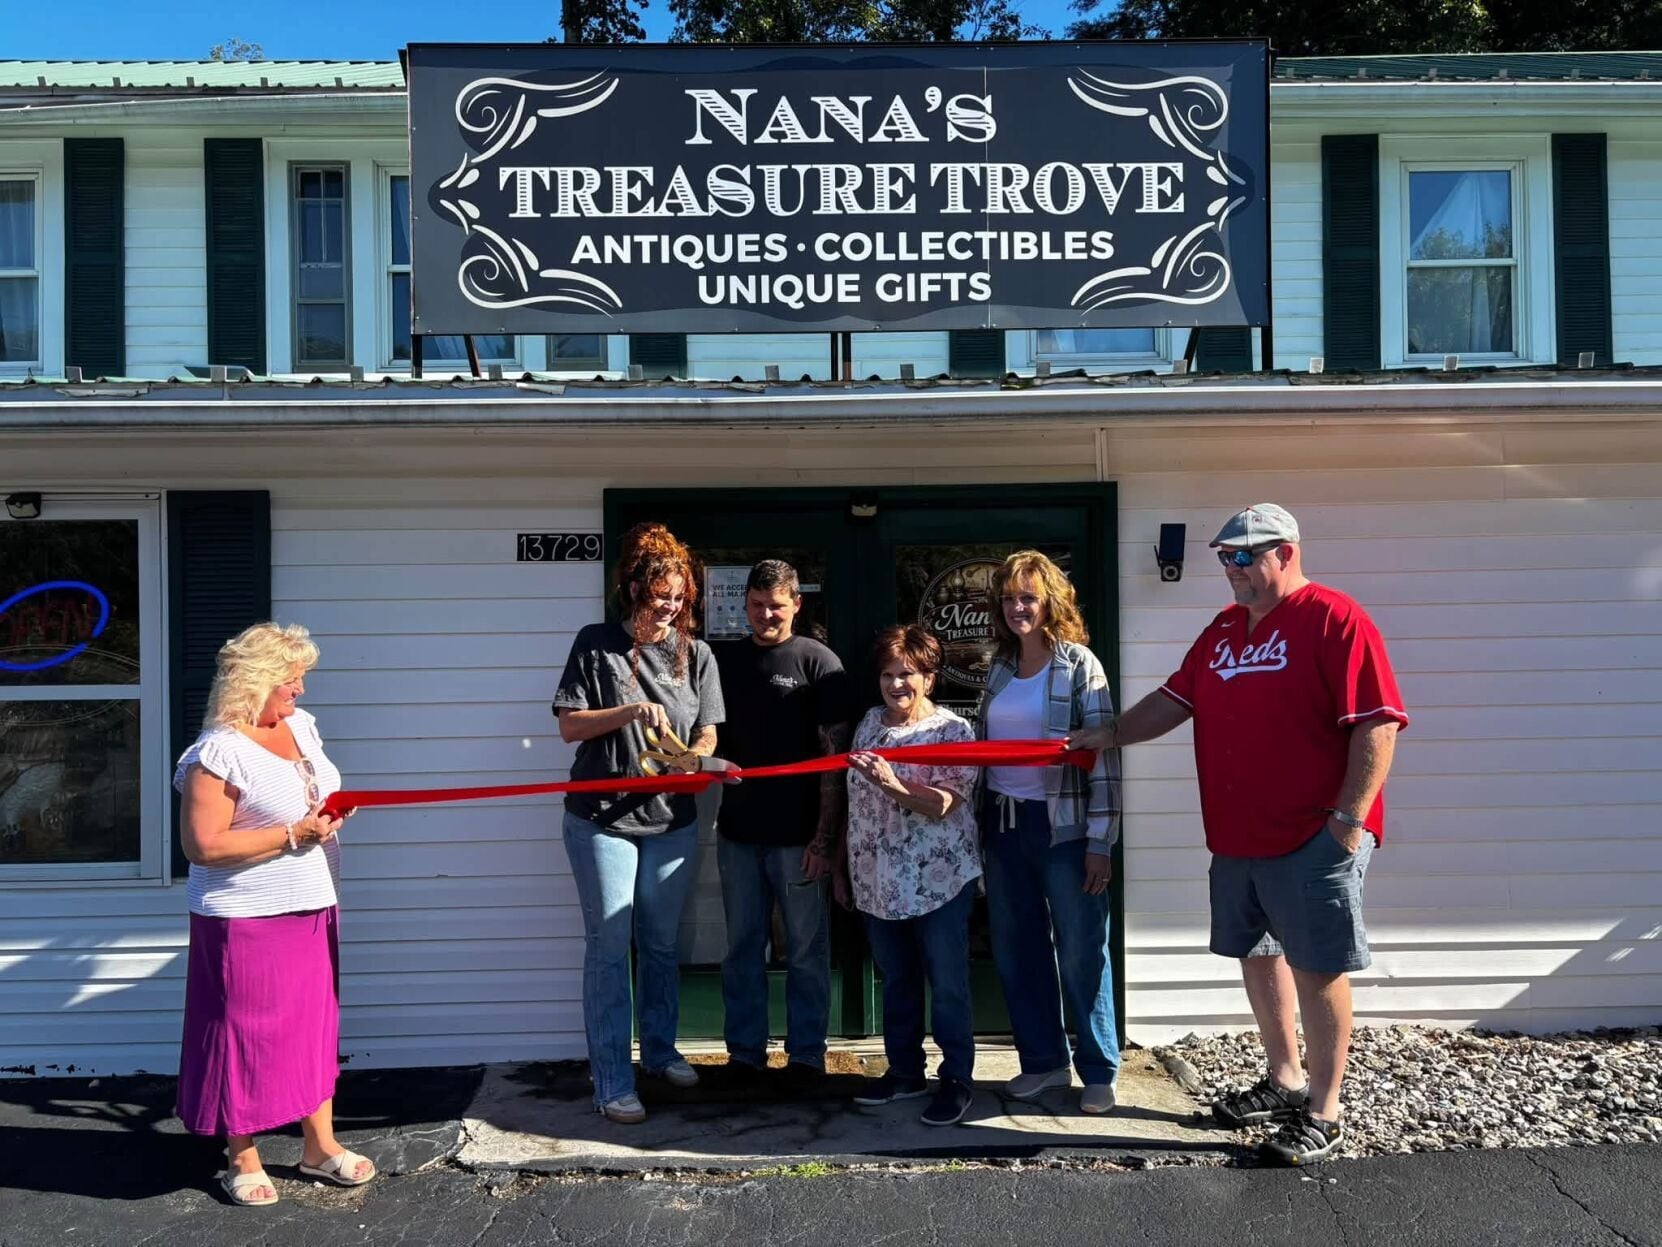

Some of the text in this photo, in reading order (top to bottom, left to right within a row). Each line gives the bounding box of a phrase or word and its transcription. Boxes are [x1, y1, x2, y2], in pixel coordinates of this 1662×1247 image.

[685, 86, 997, 146] NANA'S
[499, 161, 1185, 218] TREASURE TROVE
[571, 230, 1115, 267] ANTIQUES COLLECTIBLES
[698, 271, 992, 309] UNIQUE GIFTS
[520, 535, 601, 561] 13729
[934, 603, 991, 631] Nan
[946, 627, 989, 641] TREASURE
[1209, 629, 1288, 681] Reds
